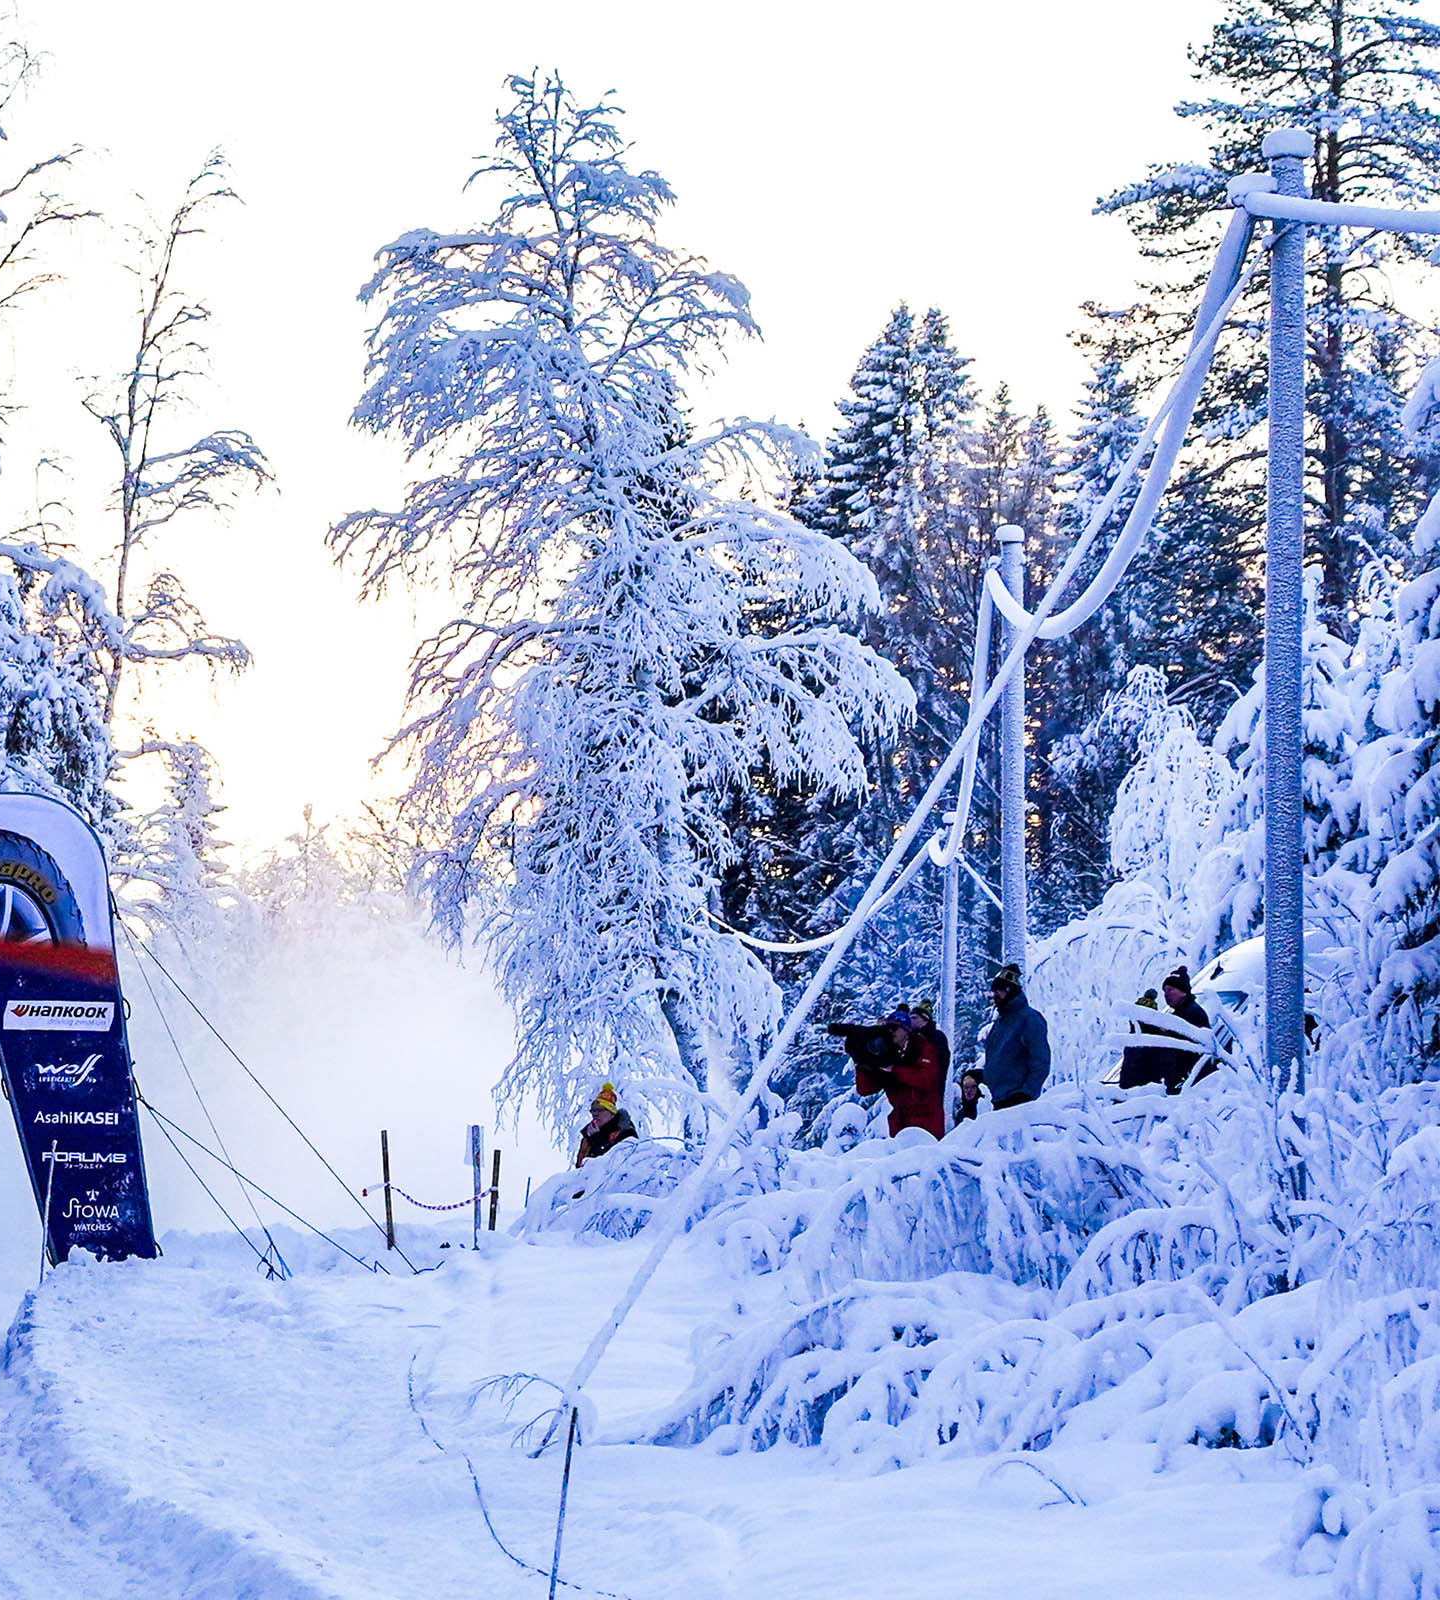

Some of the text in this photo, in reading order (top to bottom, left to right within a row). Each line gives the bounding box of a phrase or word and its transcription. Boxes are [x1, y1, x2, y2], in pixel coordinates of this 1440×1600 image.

[42, 1151, 127, 1163] FORUM8
[62, 1197, 120, 1218] STOWA
[73, 1223, 112, 1231] WATCHES
